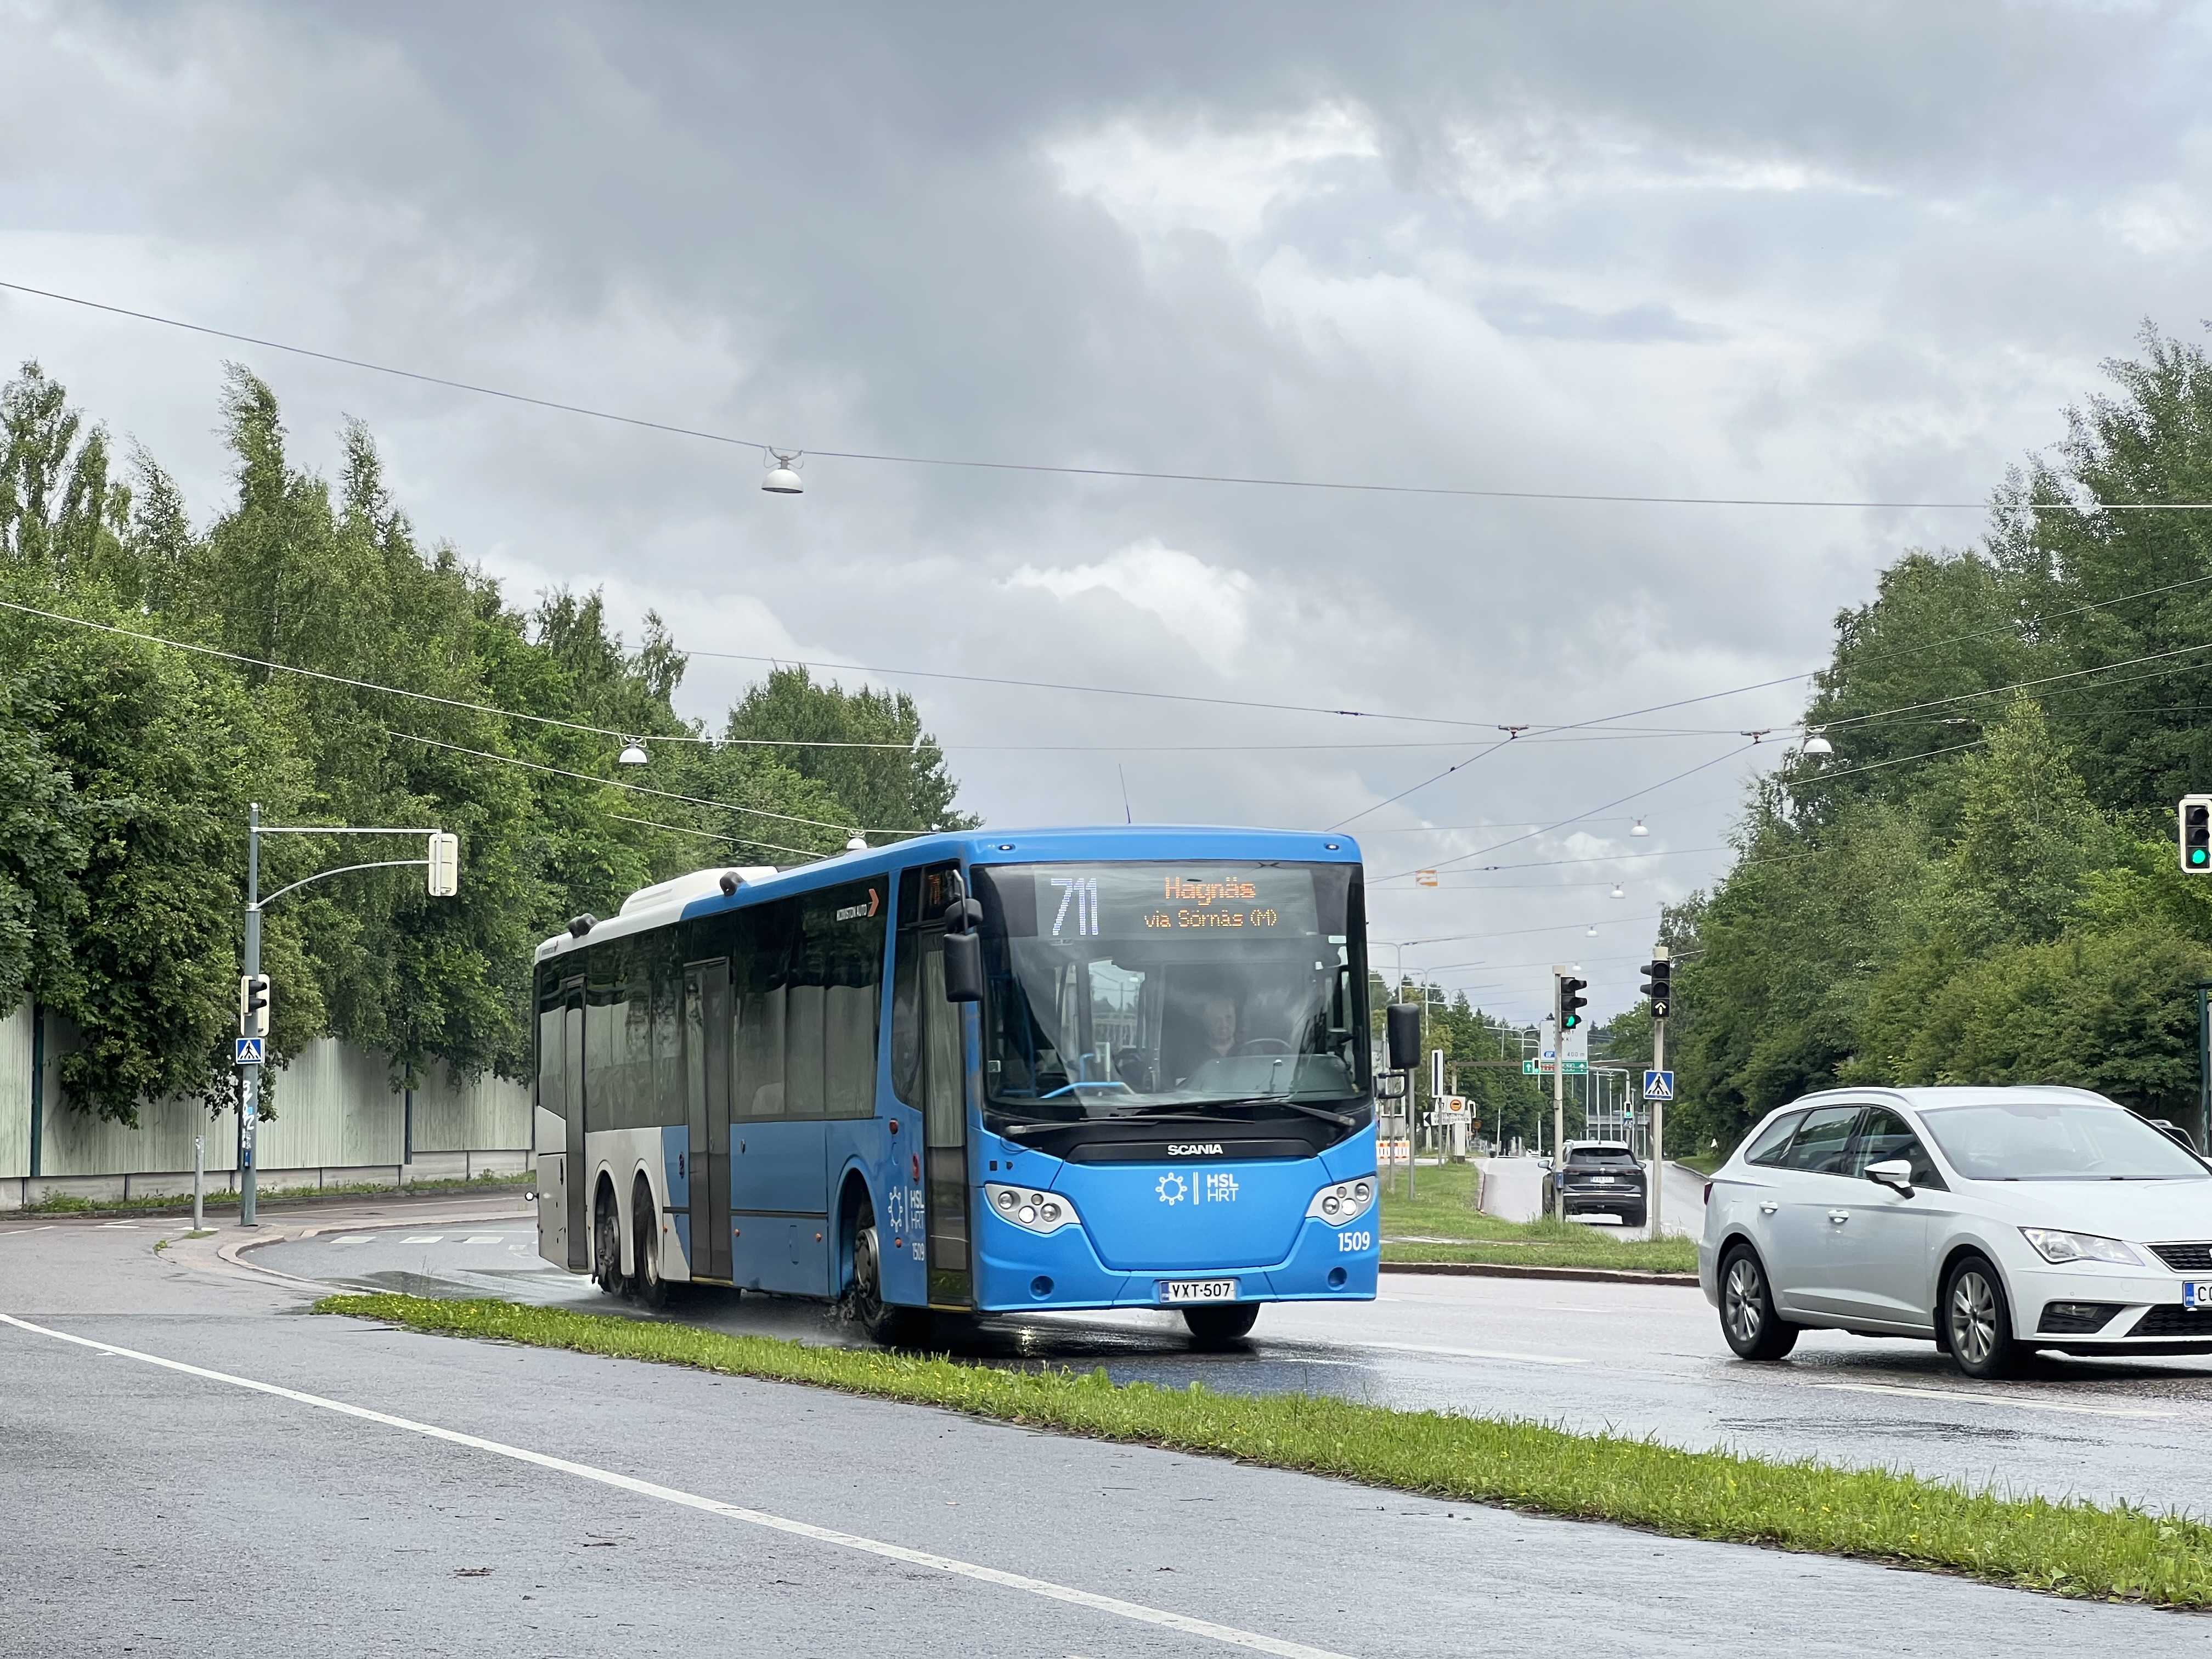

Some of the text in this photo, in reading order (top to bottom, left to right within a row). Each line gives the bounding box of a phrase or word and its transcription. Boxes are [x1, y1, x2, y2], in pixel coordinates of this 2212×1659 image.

[1165, 877, 1256, 906] Hagnäs
[1051, 878, 1098, 935] 711
[1144, 909, 1277, 928] via Sörnäs (M)
[1167, 1144, 1223, 1155] SCANIA
[1207, 1173, 1239, 1188] HSL
[910, 1190, 924, 1209] HSL
[1207, 1188, 1239, 1201] HRT
[911, 1210, 924, 1229] HRT
[1338, 1231, 1370, 1252] 1509
[1172, 1283, 1231, 1298] VXT-507
